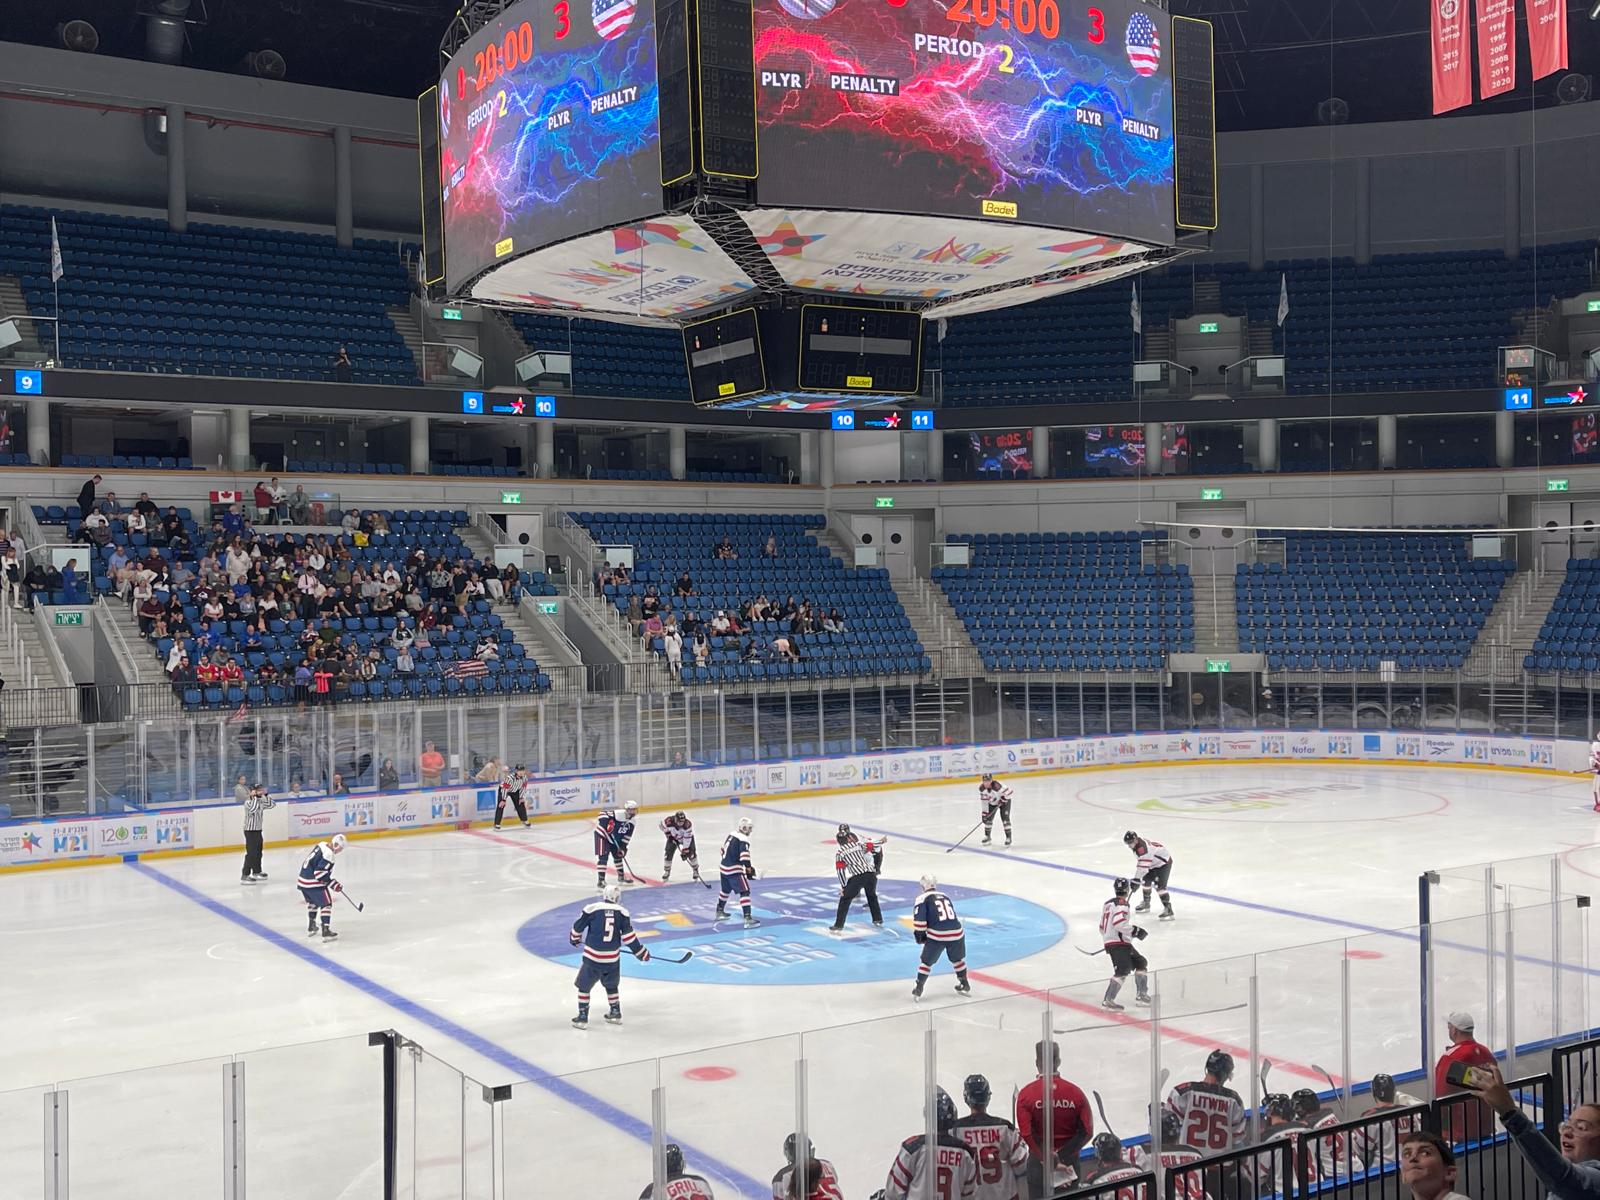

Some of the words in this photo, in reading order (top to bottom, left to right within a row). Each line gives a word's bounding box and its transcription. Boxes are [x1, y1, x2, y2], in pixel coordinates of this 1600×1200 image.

[554, 3, 570, 40] 3
[946, 0, 1060, 39] 20:00
[1088, 8, 1106, 44] 3
[1490, 32, 1506, 43] 1997
[914, 34, 986, 59] PERIOD
[1490, 43, 1507, 55] 2007
[475, 22, 533, 92] 20:00
[998, 44, 1014, 74] 2
[1442, 50, 1458, 62] 2015
[1490, 55, 1508, 66] 2008
[1443, 61, 1458, 72] 2017
[1491, 66, 1510, 78] 2019
[762, 72, 802, 89] PLYR
[830, 75, 896, 96] PENALTY
[1492, 77, 1510, 88] 2020
[498, 92, 508, 118] 2
[591, 86, 637, 113] PENALTY
[467, 100, 494, 130] PERIOD
[548, 110, 570, 130] PLYR
[1076, 108, 1102, 126] PLYR
[1122, 118, 1159, 140] PENALTY
[22, 376, 32, 390] 9
[468, 398, 478, 409] 9
[538, 402, 552, 412] 10
[1512, 394, 1528, 404] 11
[837, 416, 852, 426] 10
[914, 416, 928, 426] 11
[58, 614, 80, 624] יציאה
[1292, 746, 1316, 754] Nofar
[1426, 740, 1454, 748] Reebok
[694, 780, 715, 790] ספורט
[715, 778, 729, 788] מגה
[734, 775, 756, 790] M21
[550, 786, 580, 796] Reebok
[344, 810, 374, 827] M21
[388, 812, 416, 824] Nofar
[432, 802, 459, 819] M21
[301, 817, 331, 826] שופרסל
[157, 826, 189, 844] M21
[54, 835, 88, 853] M21
[934, 900, 955, 921] 36
[603, 918, 615, 942] 5
[1035, 1100, 1076, 1109] CADA
[1193, 1095, 1228, 1112] LITWIN
[964, 1128, 1000, 1144] STEIN
[1186, 1110, 1228, 1149] 26
[972, 1146, 1002, 1185] 19
[667, 1180, 702, 1198] GRILL
